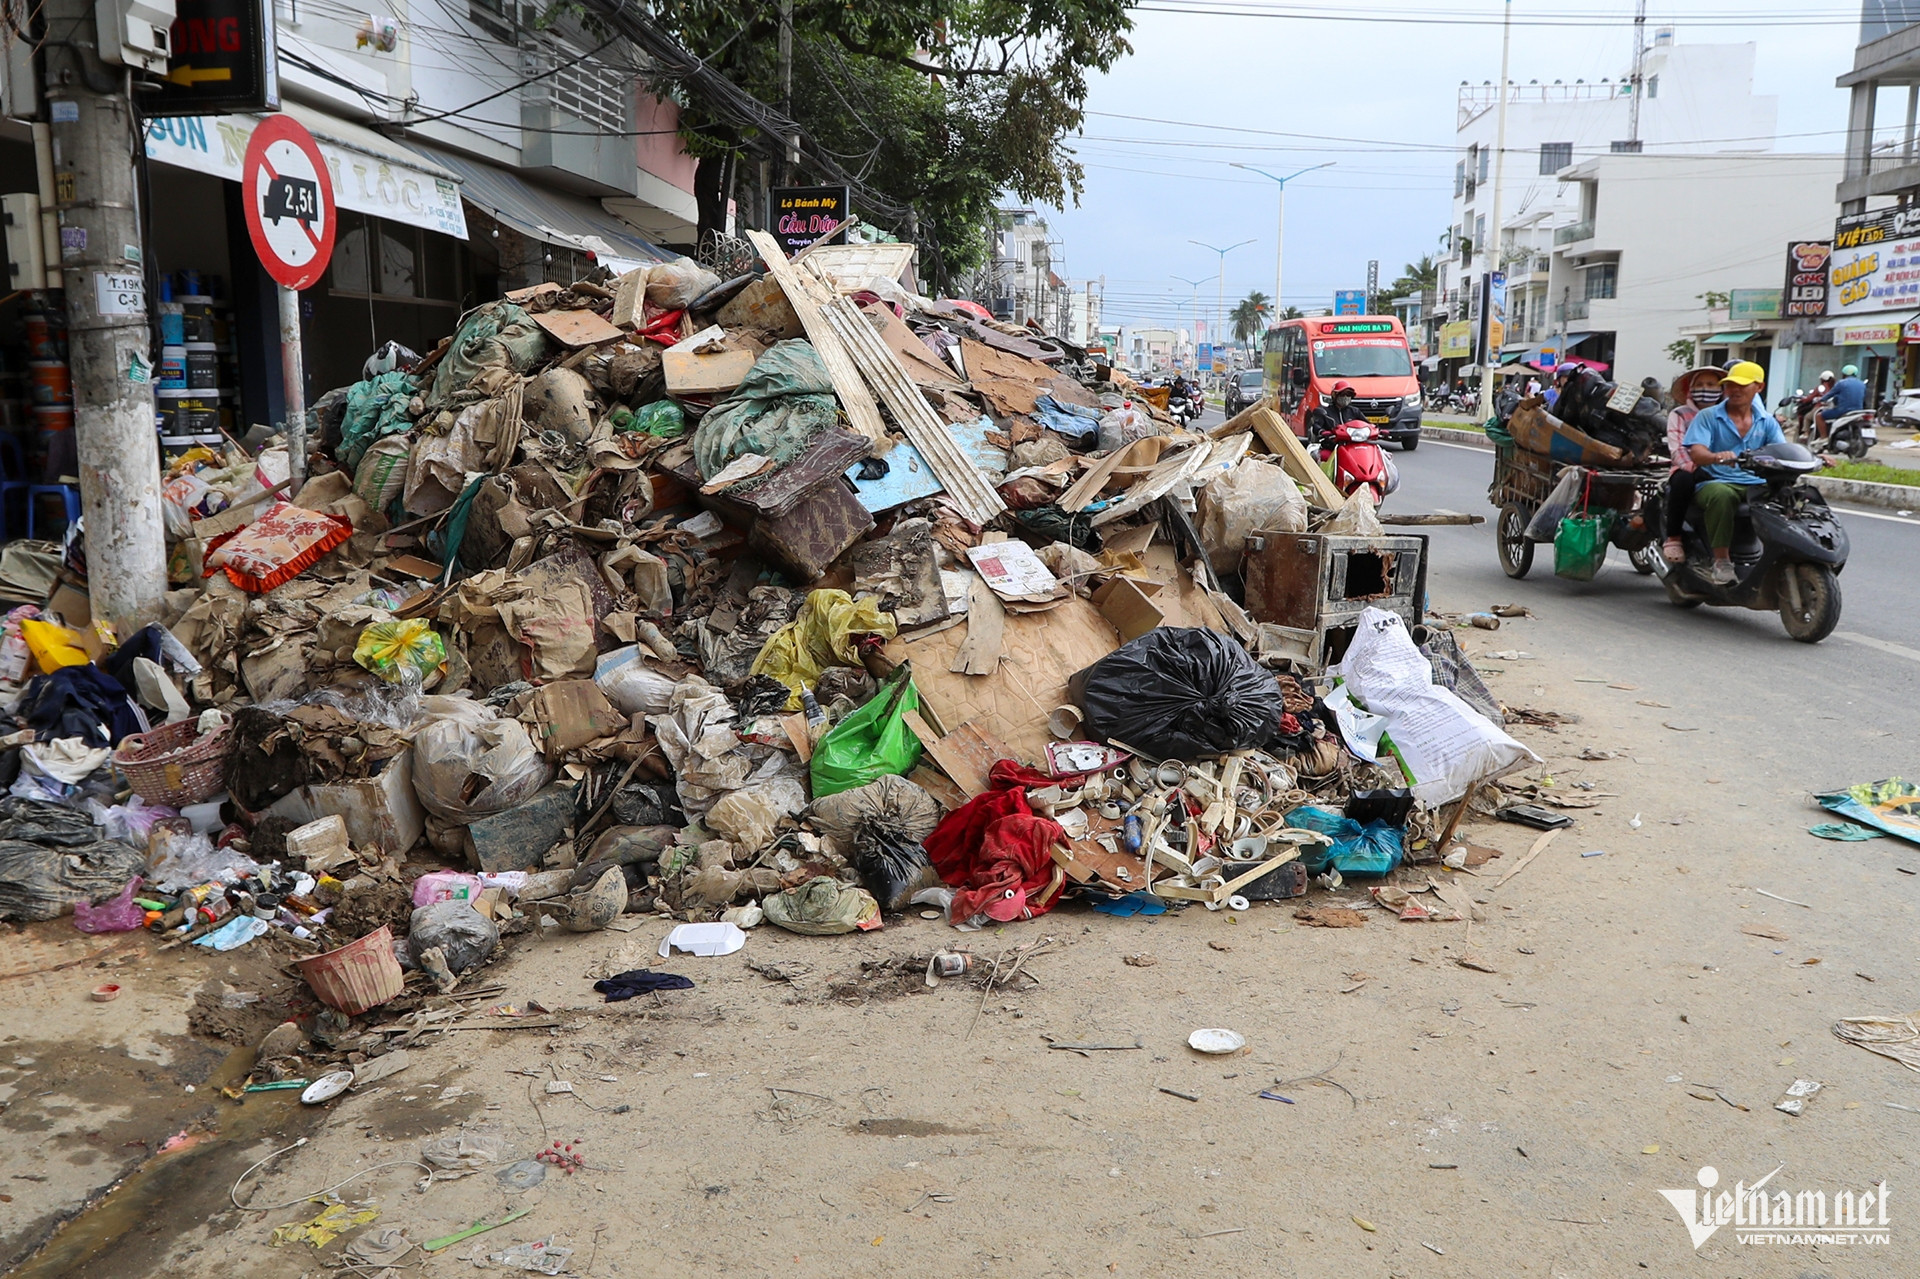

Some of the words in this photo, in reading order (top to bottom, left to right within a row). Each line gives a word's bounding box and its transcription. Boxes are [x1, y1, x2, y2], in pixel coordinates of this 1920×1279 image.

[284, 184, 313, 215] 2,5t
[794, 198, 819, 208] Bánh
[1832, 252, 1879, 287] QUẢNG
[1791, 286, 1824, 301] LED
[1840, 278, 1870, 306] CÁO
